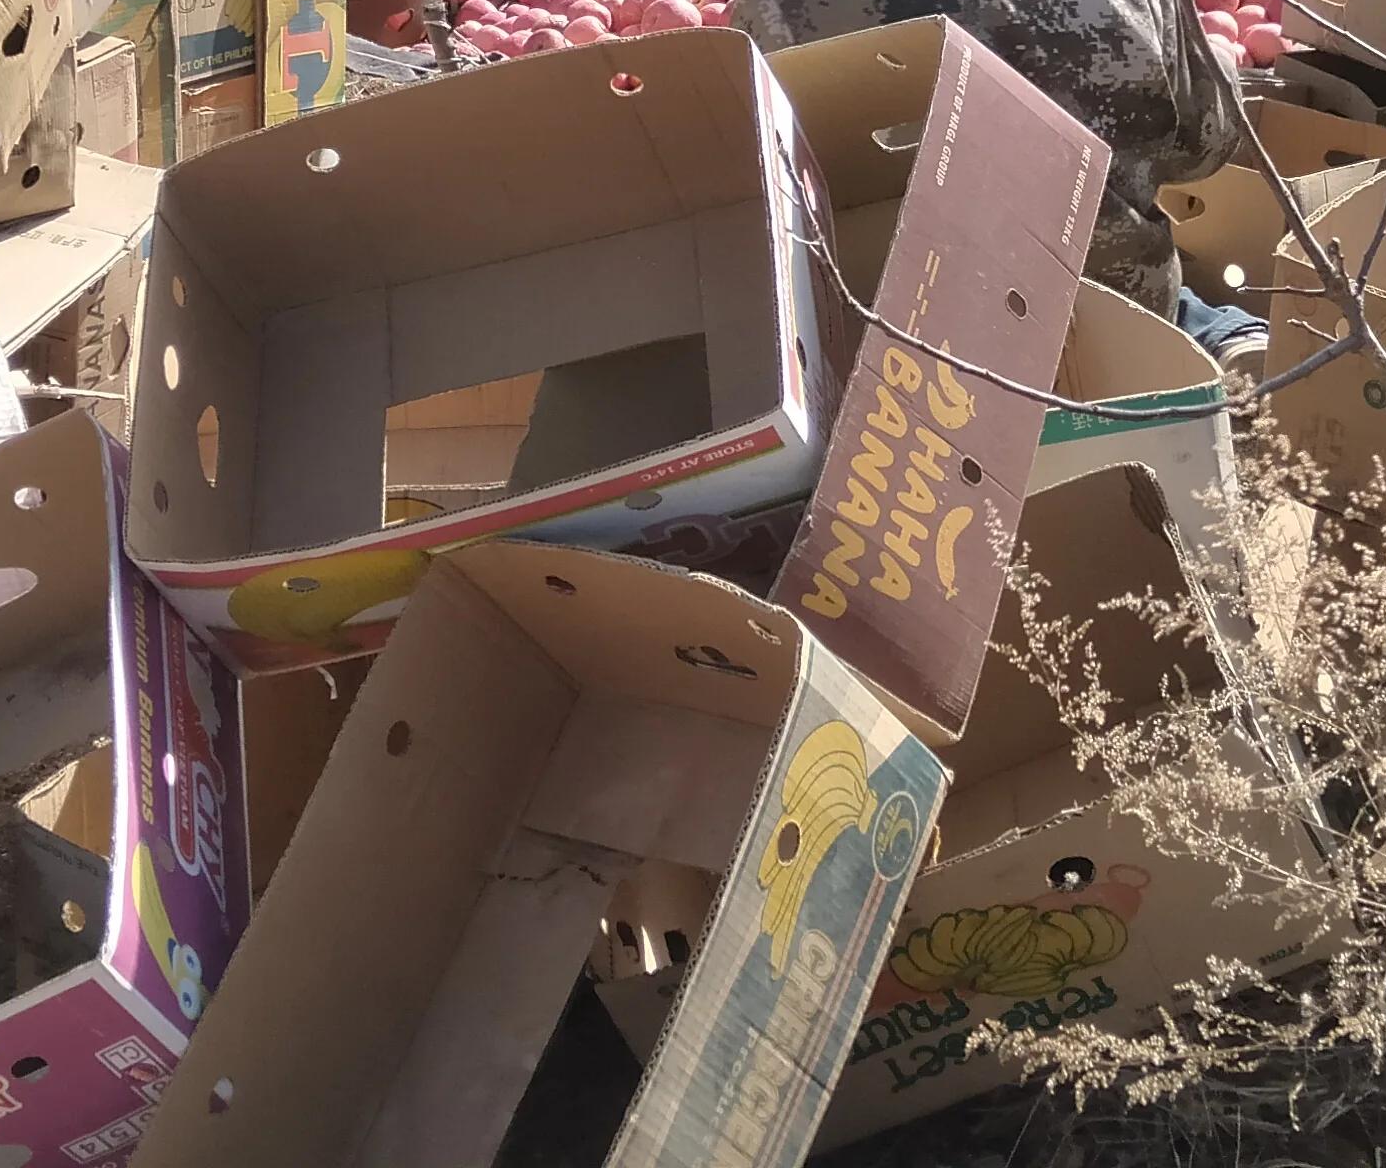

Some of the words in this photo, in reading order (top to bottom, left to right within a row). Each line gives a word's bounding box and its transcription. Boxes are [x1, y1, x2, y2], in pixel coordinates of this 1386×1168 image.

[955, 44, 973, 96] PRODUCT
[945, 112, 960, 145] HAGL
[934, 145, 951, 188] GROUP
[1080, 144, 1092, 168] NET
[1069, 169, 1086, 215] WEIGHT
[1061, 215, 1075, 247] 13KG
[677, 453, 701, 470] AT
[707, 437, 756, 463] STORE
[801, 345, 924, 621] BANANA
[869, 427, 952, 602] HAHA
[131, 582, 150, 685] emium
[137, 688, 156, 827] Bananas
